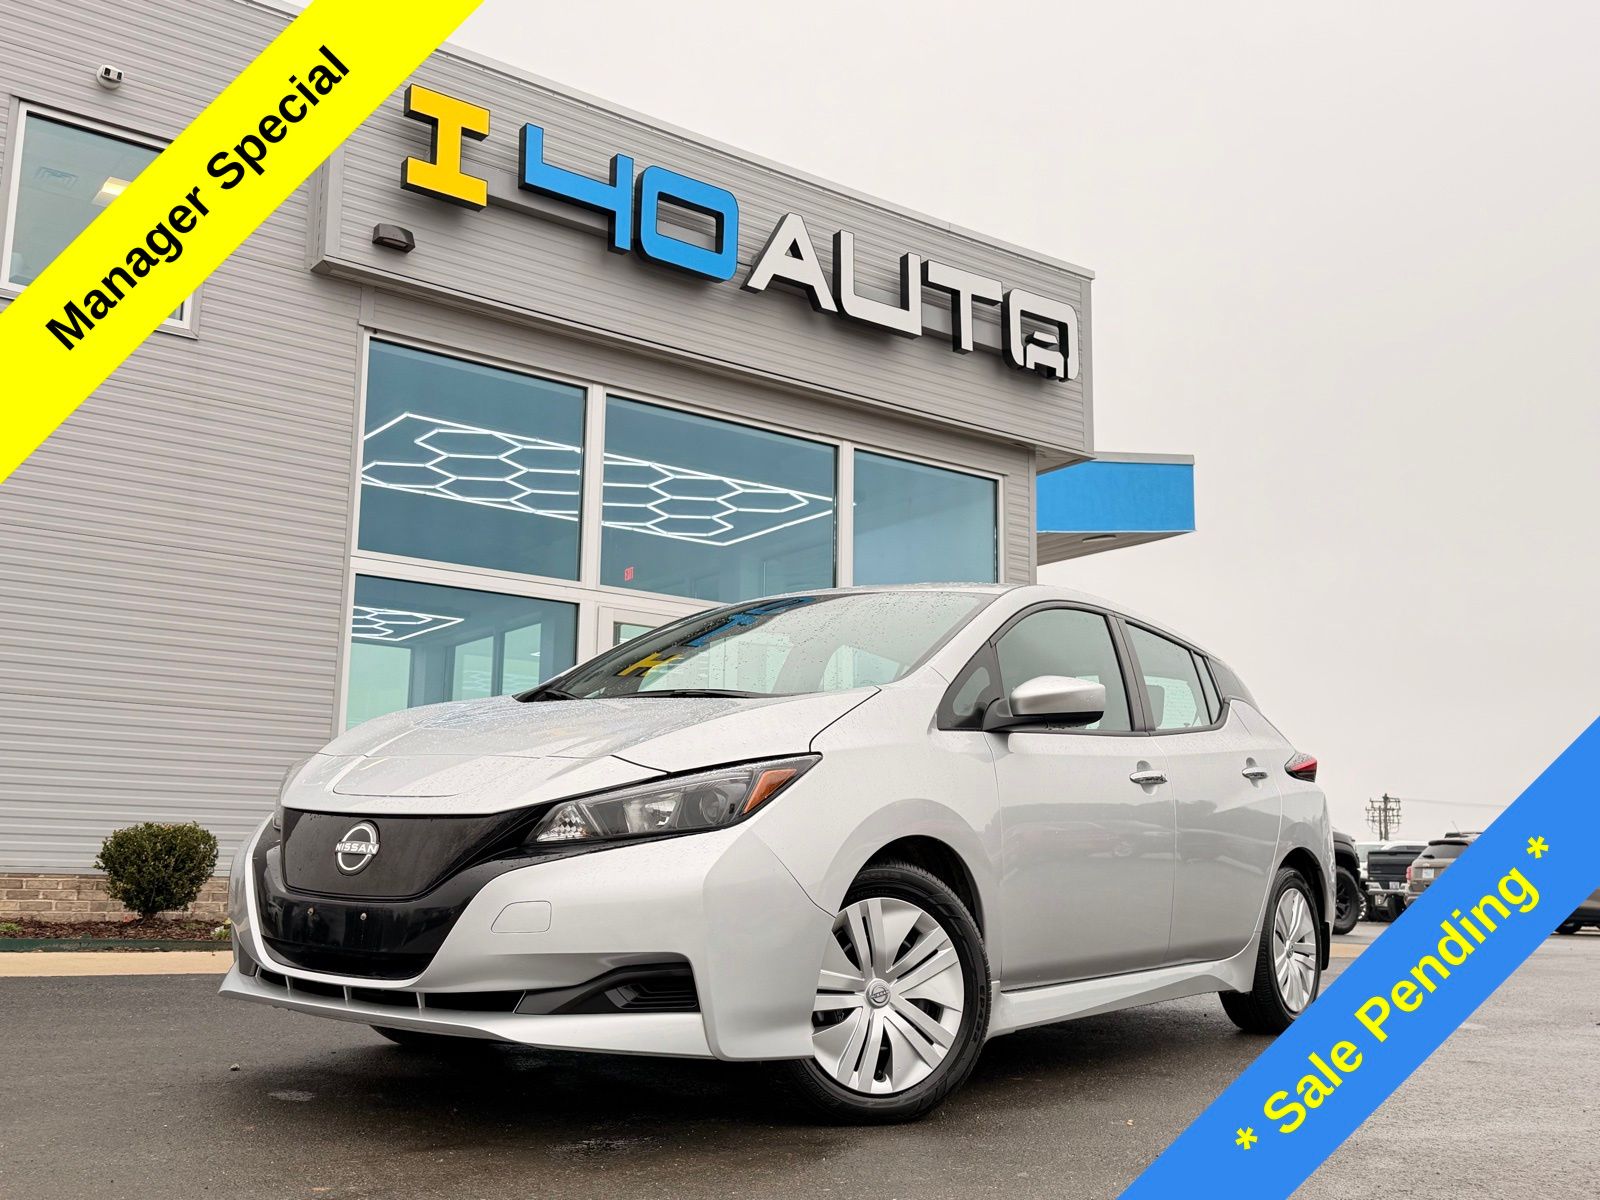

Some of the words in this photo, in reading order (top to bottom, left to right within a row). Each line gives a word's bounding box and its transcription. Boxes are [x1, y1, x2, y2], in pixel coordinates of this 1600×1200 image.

[518, 122, 739, 282] 40
[740, 212, 1078, 381] AUTO
[335, 842, 378, 854] NISSAN
